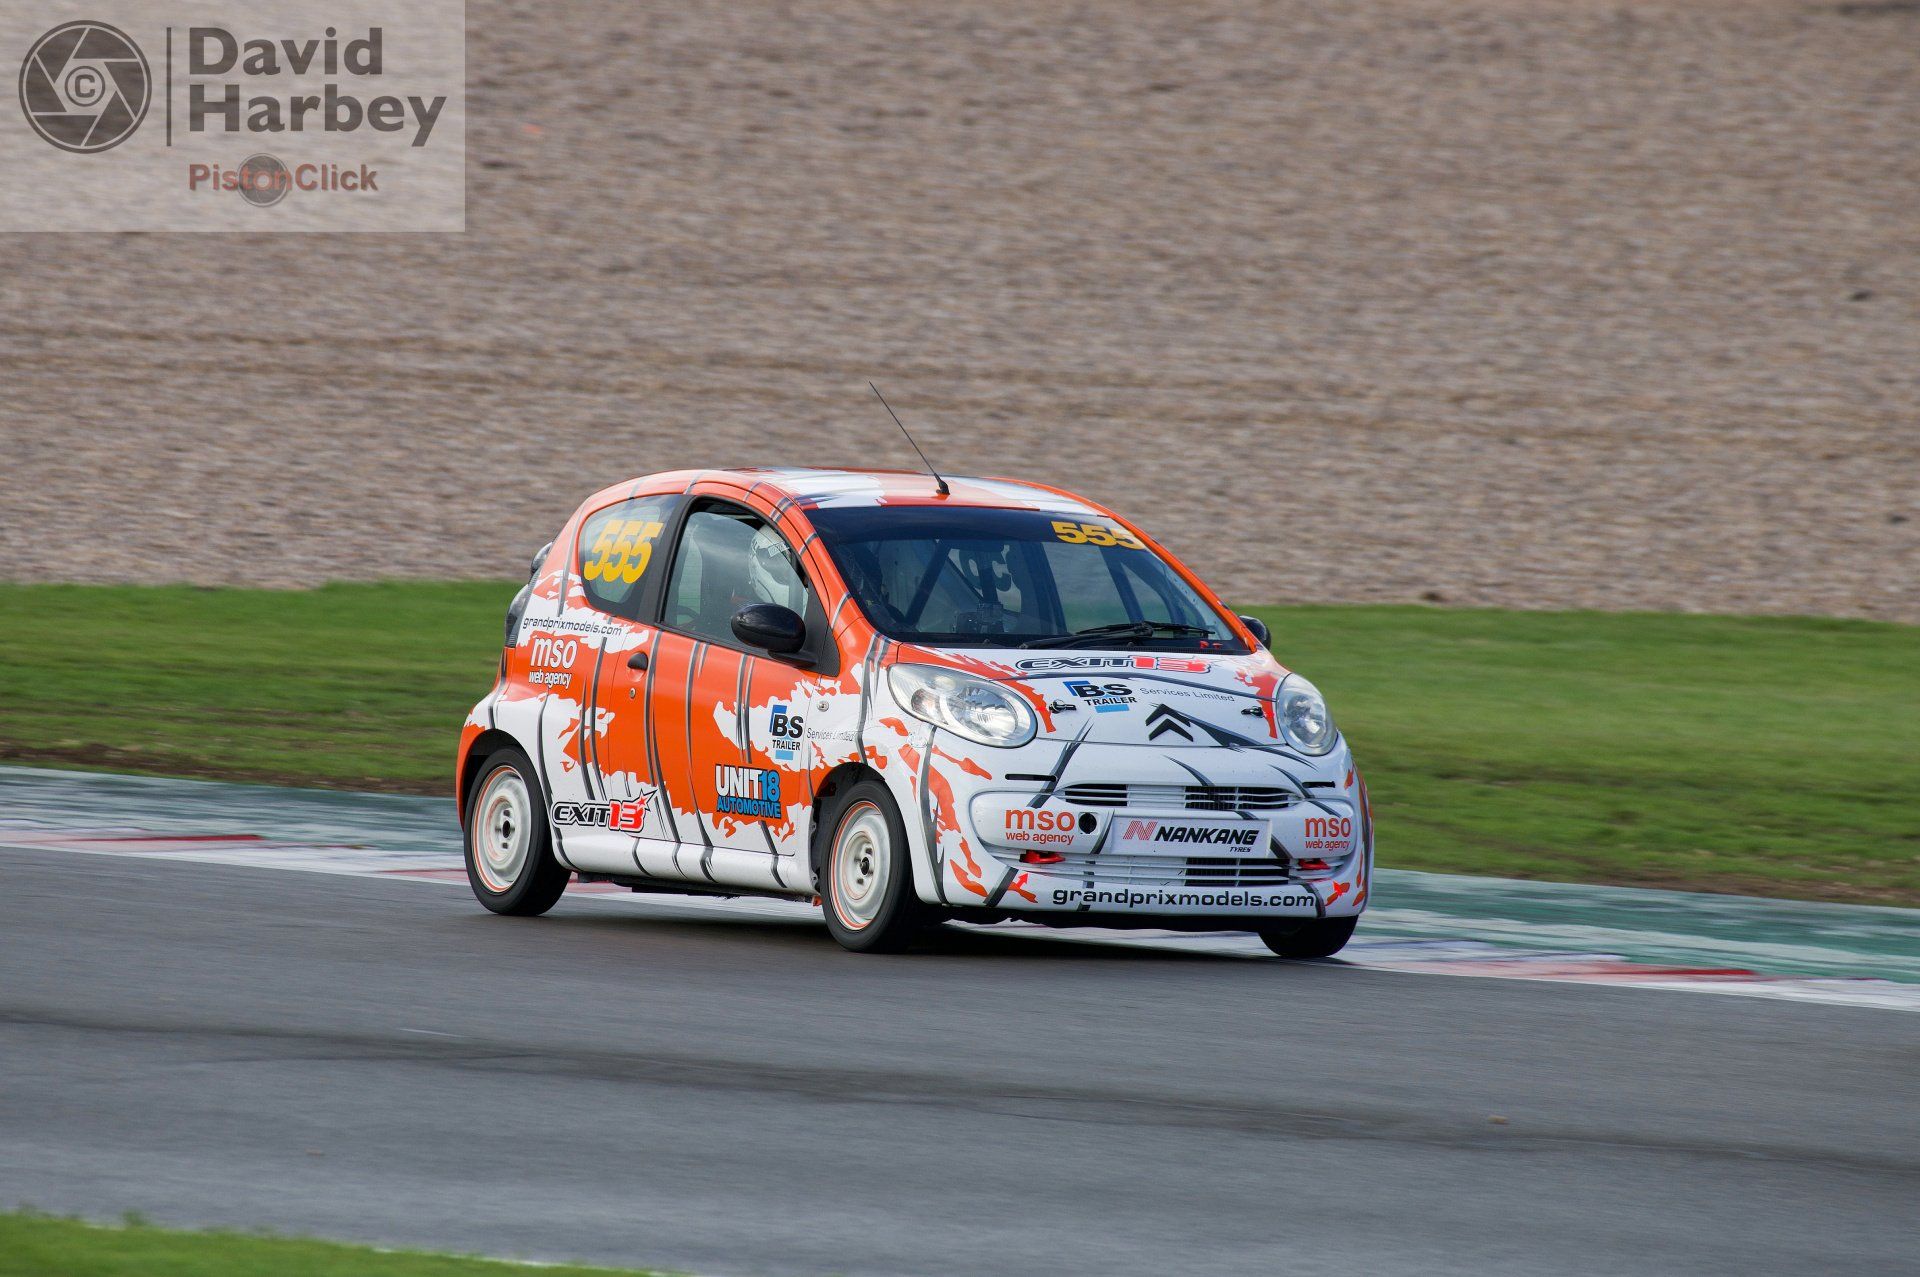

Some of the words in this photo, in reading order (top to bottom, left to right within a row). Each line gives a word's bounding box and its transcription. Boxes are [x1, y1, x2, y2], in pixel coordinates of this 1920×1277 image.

[1051, 521, 1146, 550] 555
[583, 519, 663, 584] 555
[523, 616, 622, 636] grandprixmodels.com
[530, 637, 578, 669] mso
[528, 669, 544, 684] web
[544, 673, 572, 689] agency
[1074, 683, 1132, 698] BS
[1140, 687, 1190, 697] Services
[1192, 691, 1235, 702] Limited
[1084, 696, 1137, 706] TRAILER
[772, 714, 804, 739] BS
[772, 739, 801, 751] TRAILER
[716, 797, 782, 818] AUTOMOTIVE
[1005, 809, 1075, 831] mso
[1304, 817, 1352, 838] mso
[1005, 831, 1030, 841] web
[1032, 833, 1075, 846] agency
[1154, 826, 1259, 845] NANKANG
[1305, 839, 1324, 849] web
[1324, 841, 1351, 852] agency
[1052, 888, 1316, 908] grandprixmodels.com
